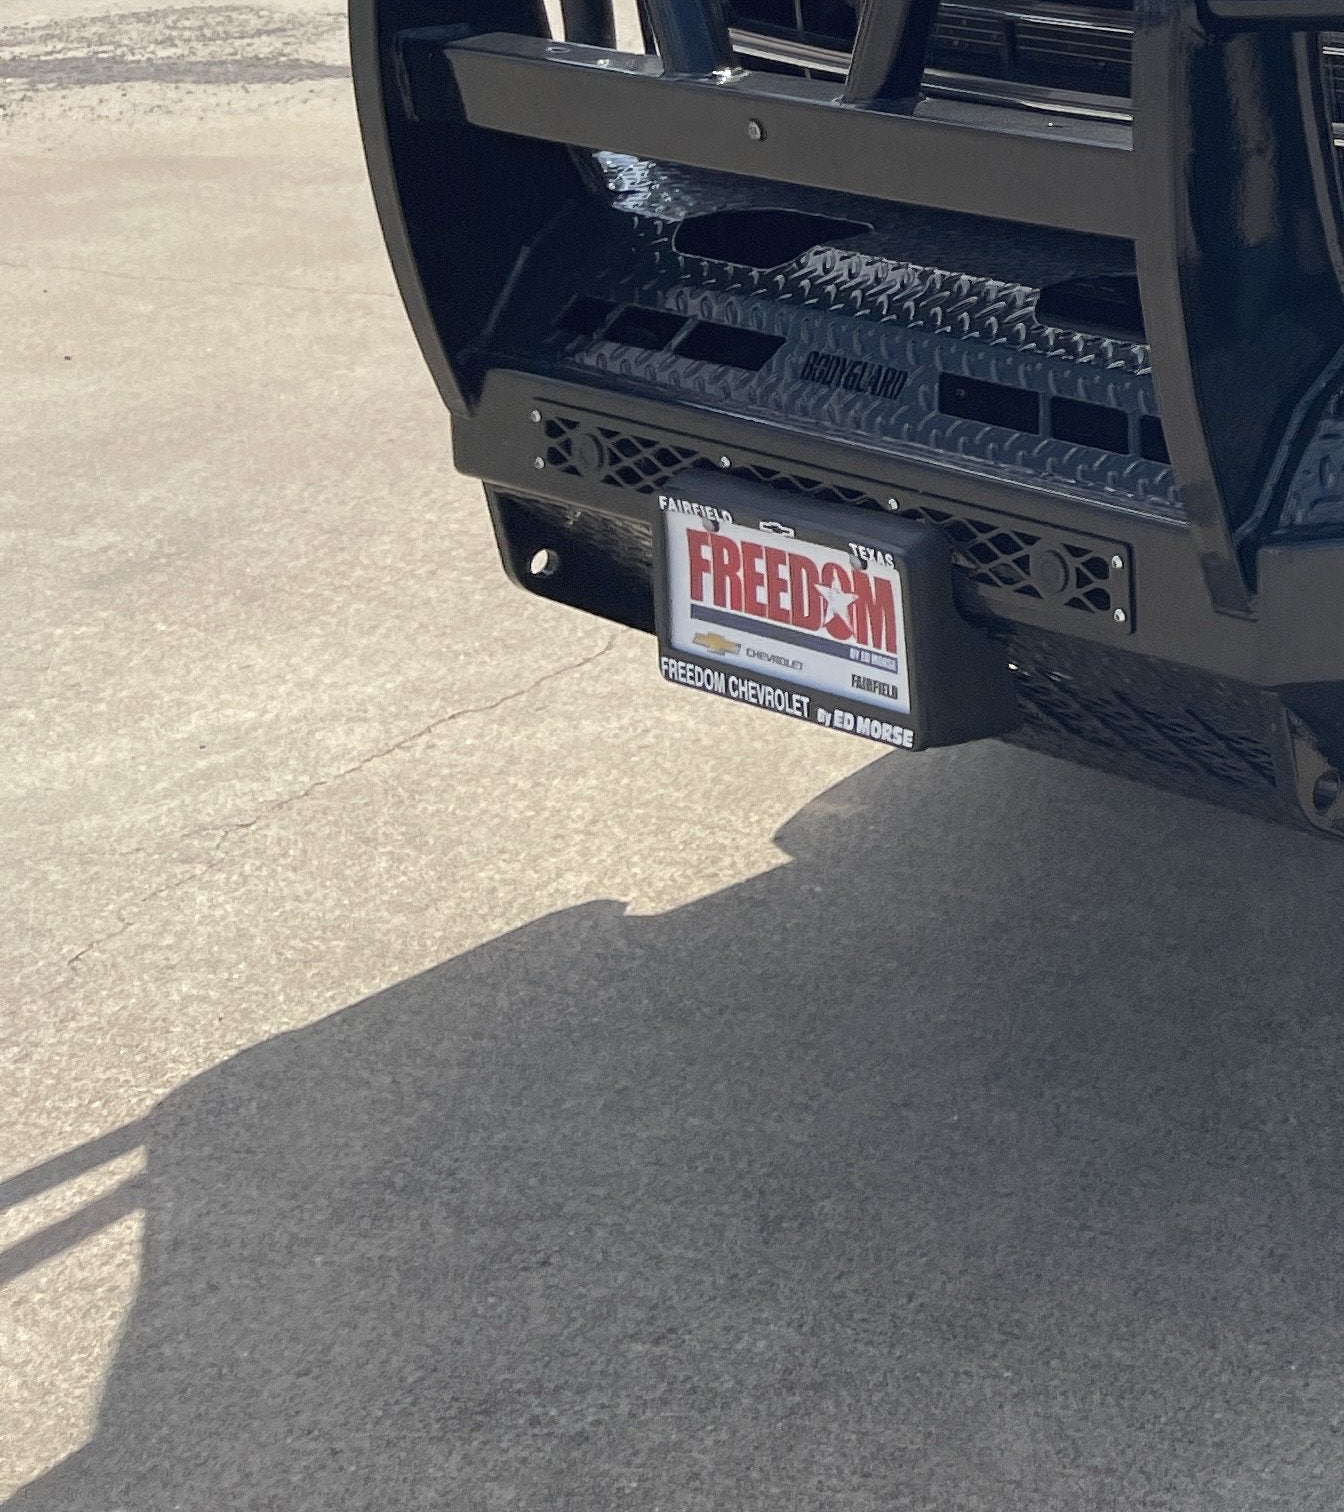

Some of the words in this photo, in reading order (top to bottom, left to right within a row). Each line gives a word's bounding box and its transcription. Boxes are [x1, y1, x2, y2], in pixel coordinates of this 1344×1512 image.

[801, 351, 909, 400] BODYGUARD
[659, 495, 734, 524] FAIRFIELD
[848, 542, 896, 569] TEXAS
[686, 528, 897, 654] FREEDOM
[746, 648, 804, 670] CHEVROLET
[660, 656, 728, 694] FREEDOM
[728, 675, 810, 719] CHEVROLET
[833, 709, 854, 731] ED
[856, 715, 914, 748] MORSE
[851, 674, 898, 701] FAIRFIELD
